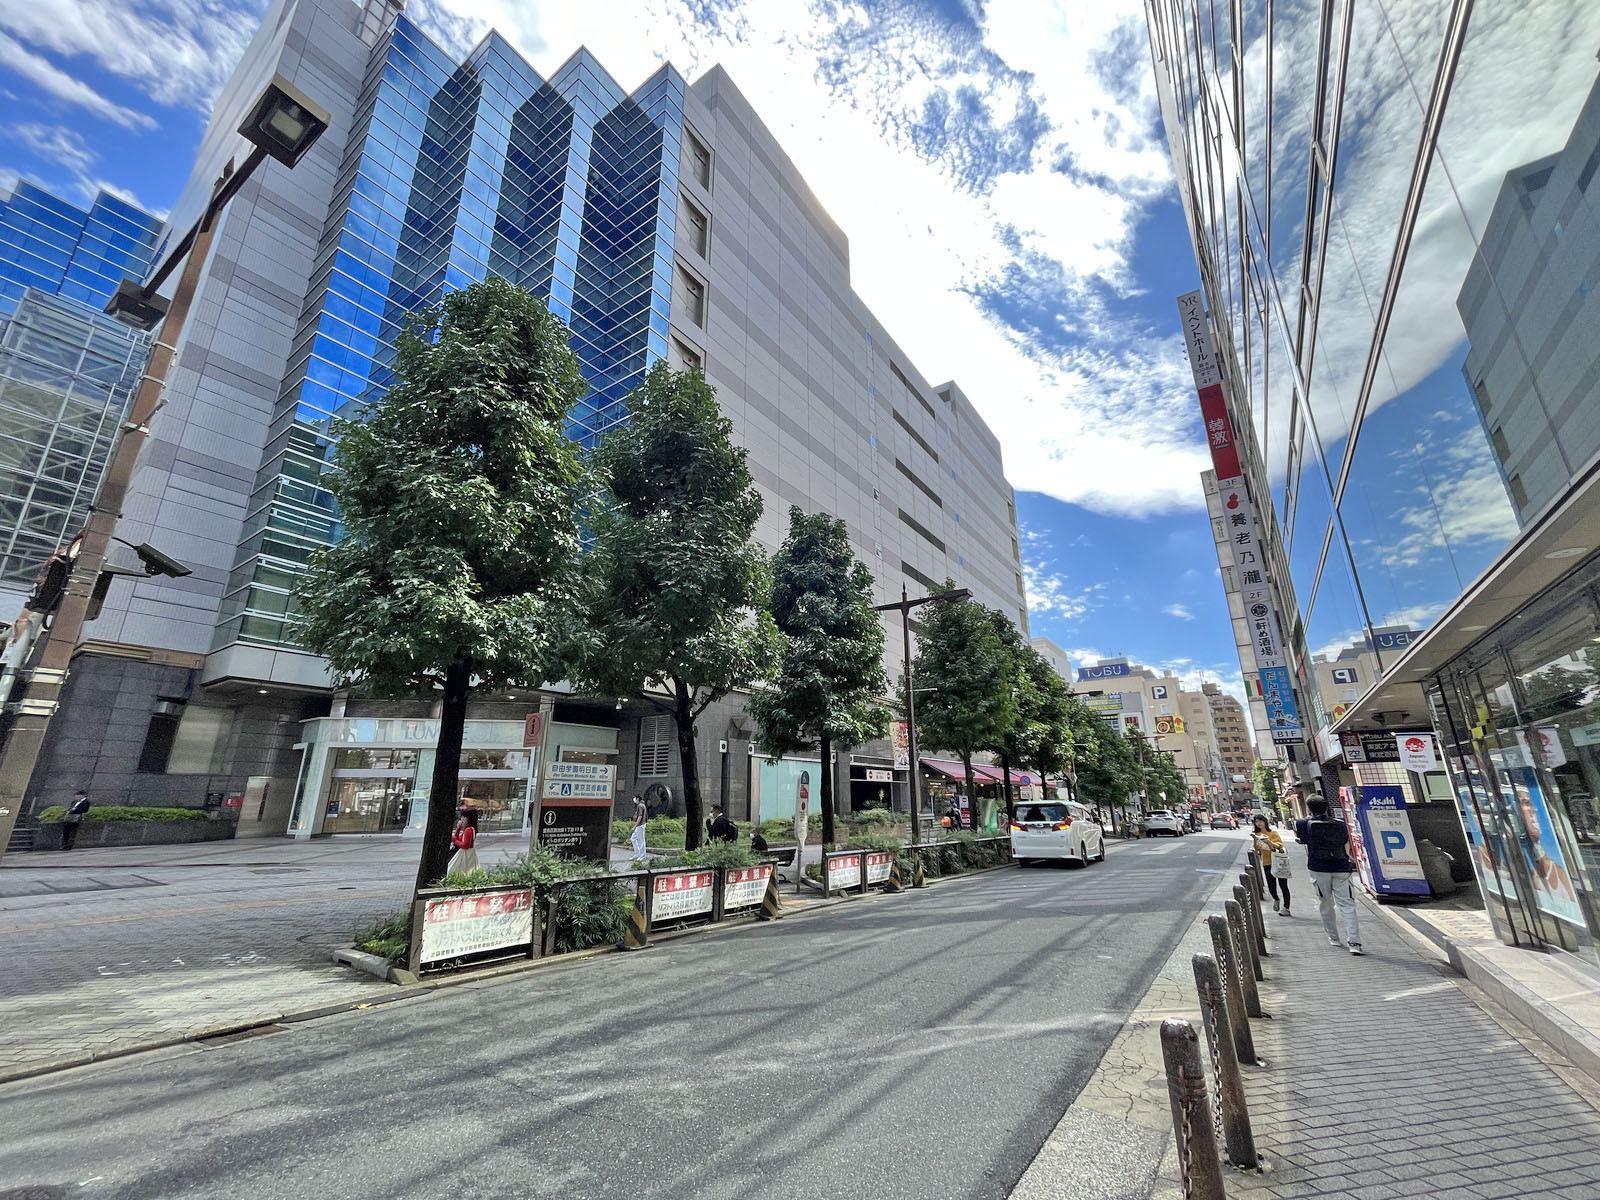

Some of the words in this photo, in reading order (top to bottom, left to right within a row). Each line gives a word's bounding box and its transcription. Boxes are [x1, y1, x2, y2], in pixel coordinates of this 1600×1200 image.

[1181, 295, 1198, 307] YR
[1187, 307, 1209, 362] イベントホール
[1225, 479, 1237, 487] 3F
[1230, 512, 1263, 585] 養老乃瀧
[1249, 591, 1262, 599] 2F
[1084, 665, 1122, 678] TOBU
[1153, 686, 1166, 699] P
[1265, 670, 1288, 727] だんまや水産
[1277, 730, 1297, 738] B1F
[551, 764, 598, 774] 自由学園明日館
[1368, 796, 1396, 806] Asahi
[1380, 830, 1406, 858] P
[727, 867, 771, 884] 駐車禁止
[657, 874, 711, 892] 駐車禁止
[432, 893, 528, 921] 駐車禁止
